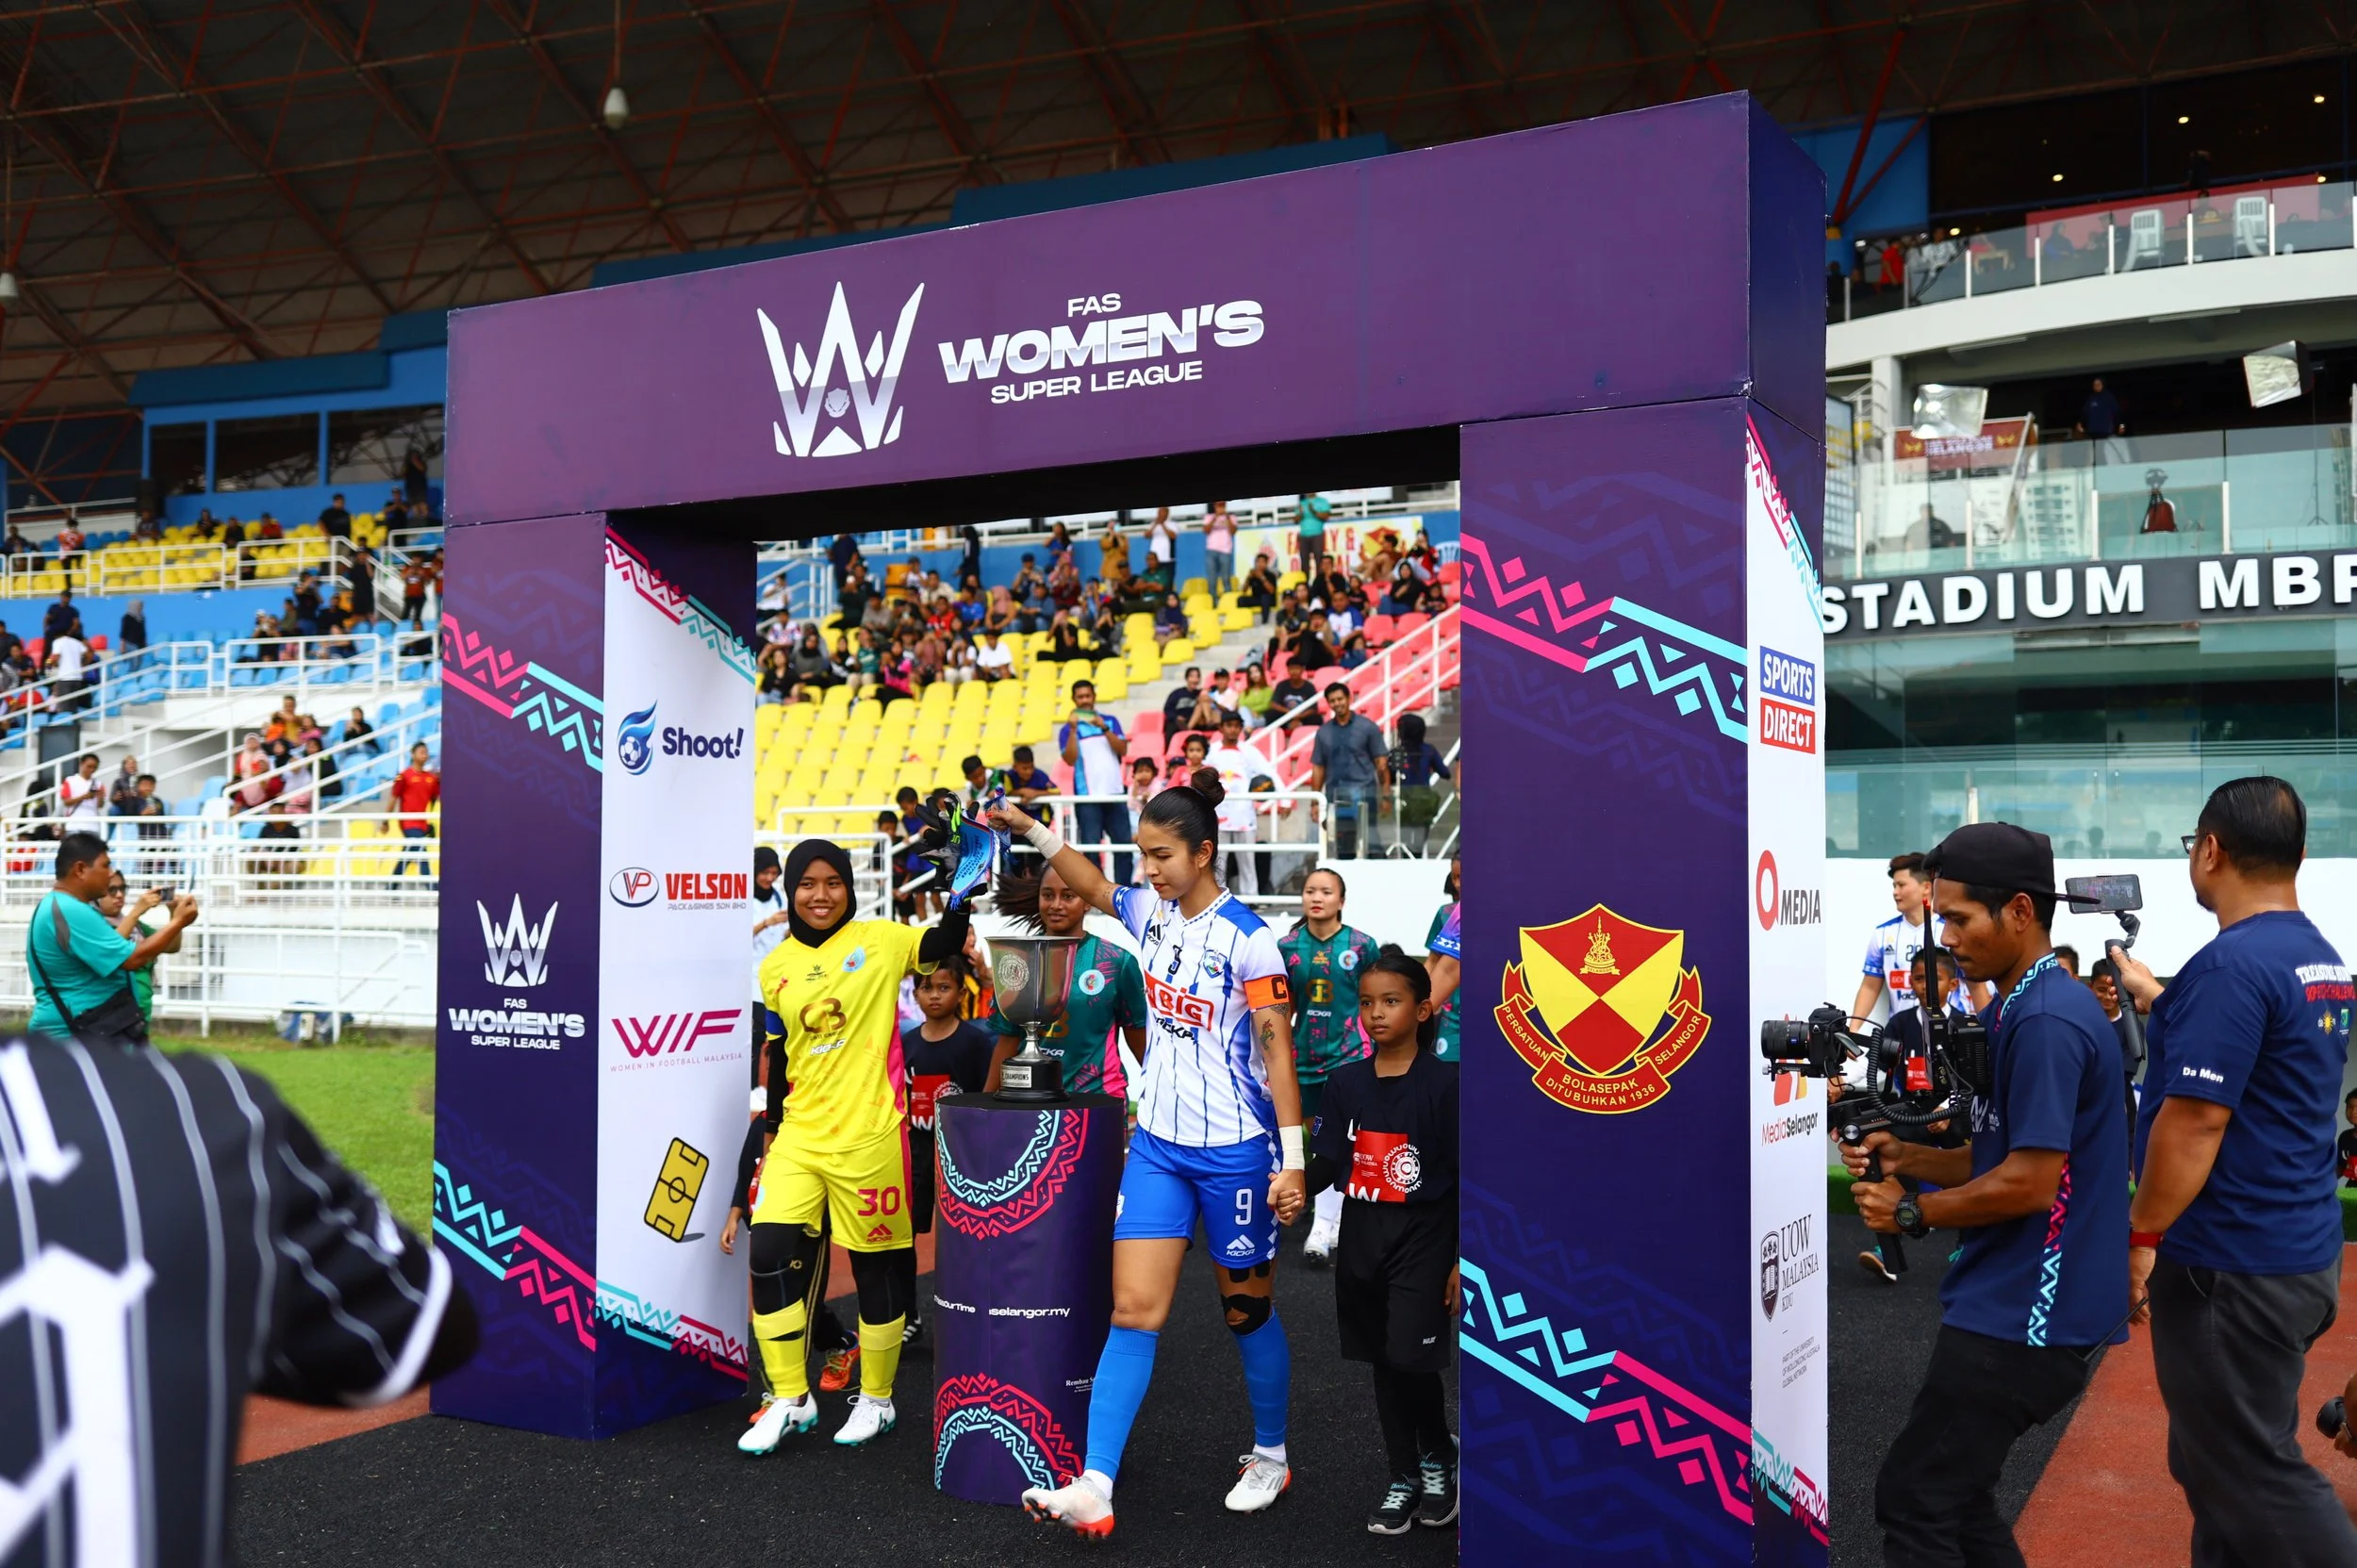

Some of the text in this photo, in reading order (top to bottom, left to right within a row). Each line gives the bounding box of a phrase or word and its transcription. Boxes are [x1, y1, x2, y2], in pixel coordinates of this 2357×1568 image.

[1067, 292, 1122, 318] FAS
[937, 299, 1265, 385] WOMEN'S
[990, 360, 1203, 404] SUPER LEAGUE
[1823, 564, 2145, 635] STADIUM
[1762, 652, 1814, 701] SPORTS
[662, 726, 745, 759] Shoot!
[1763, 704, 1812, 748] DIRECT
[666, 873, 748, 900] VELSON
[503, 998, 528, 1009] FAS
[1271, 976, 1287, 1000] C
[448, 1008, 585, 1038] WOMEN'S
[611, 1009, 742, 1058] WIF
[1502, 1006, 1551, 1062] PERSATUAN
[471, 1034, 561, 1050] SUPER LEAGUE
[1654, 1015, 1702, 1065] SELANGOR
[610, 1064, 642, 1072] WOMEN
[659, 1057, 701, 1067] FOOTBALL
[704, 1052, 743, 1063] MALAYSIA
[2183, 1066, 2224, 1083] Da Men
[1545, 1077, 1656, 1106] DITUBUHKAN 1936
[1561, 1073, 1640, 1094] BOLASEPAK
[857, 1185, 900, 1216] 30
[1235, 1188, 1253, 1226] 9
[1781, 1213, 1812, 1263] UOW
[1781, 1251, 1820, 1291] MALAYSIA
